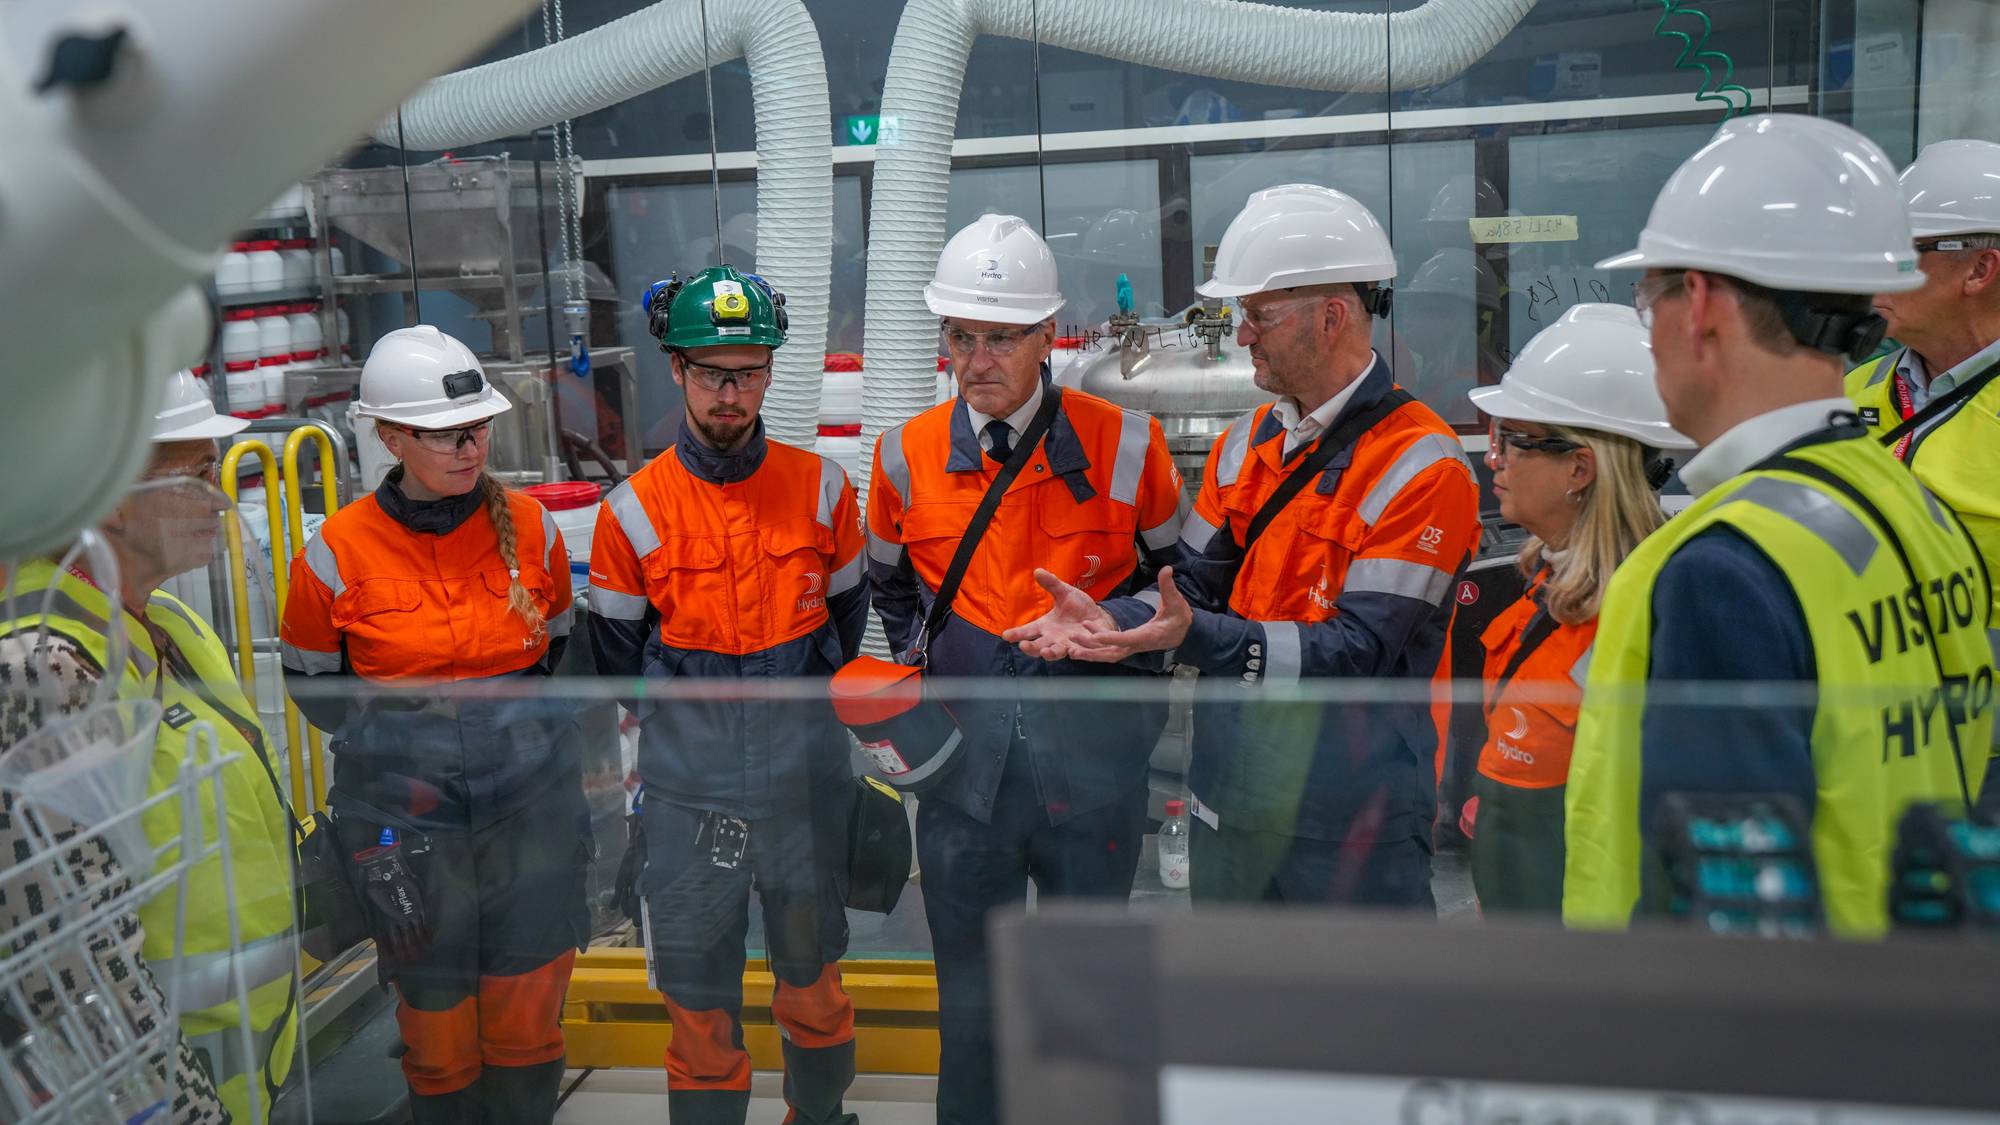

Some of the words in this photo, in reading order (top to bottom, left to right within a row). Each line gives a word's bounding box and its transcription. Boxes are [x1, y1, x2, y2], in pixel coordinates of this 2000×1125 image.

[981, 271, 1002, 280] Hydro
[976, 295, 999, 303] VISITOR
[1066, 324, 1104, 355] HAR
[1421, 525, 1444, 545] D3
[1461, 584, 1474, 600] Å
[1497, 736, 1535, 765] Hydro
